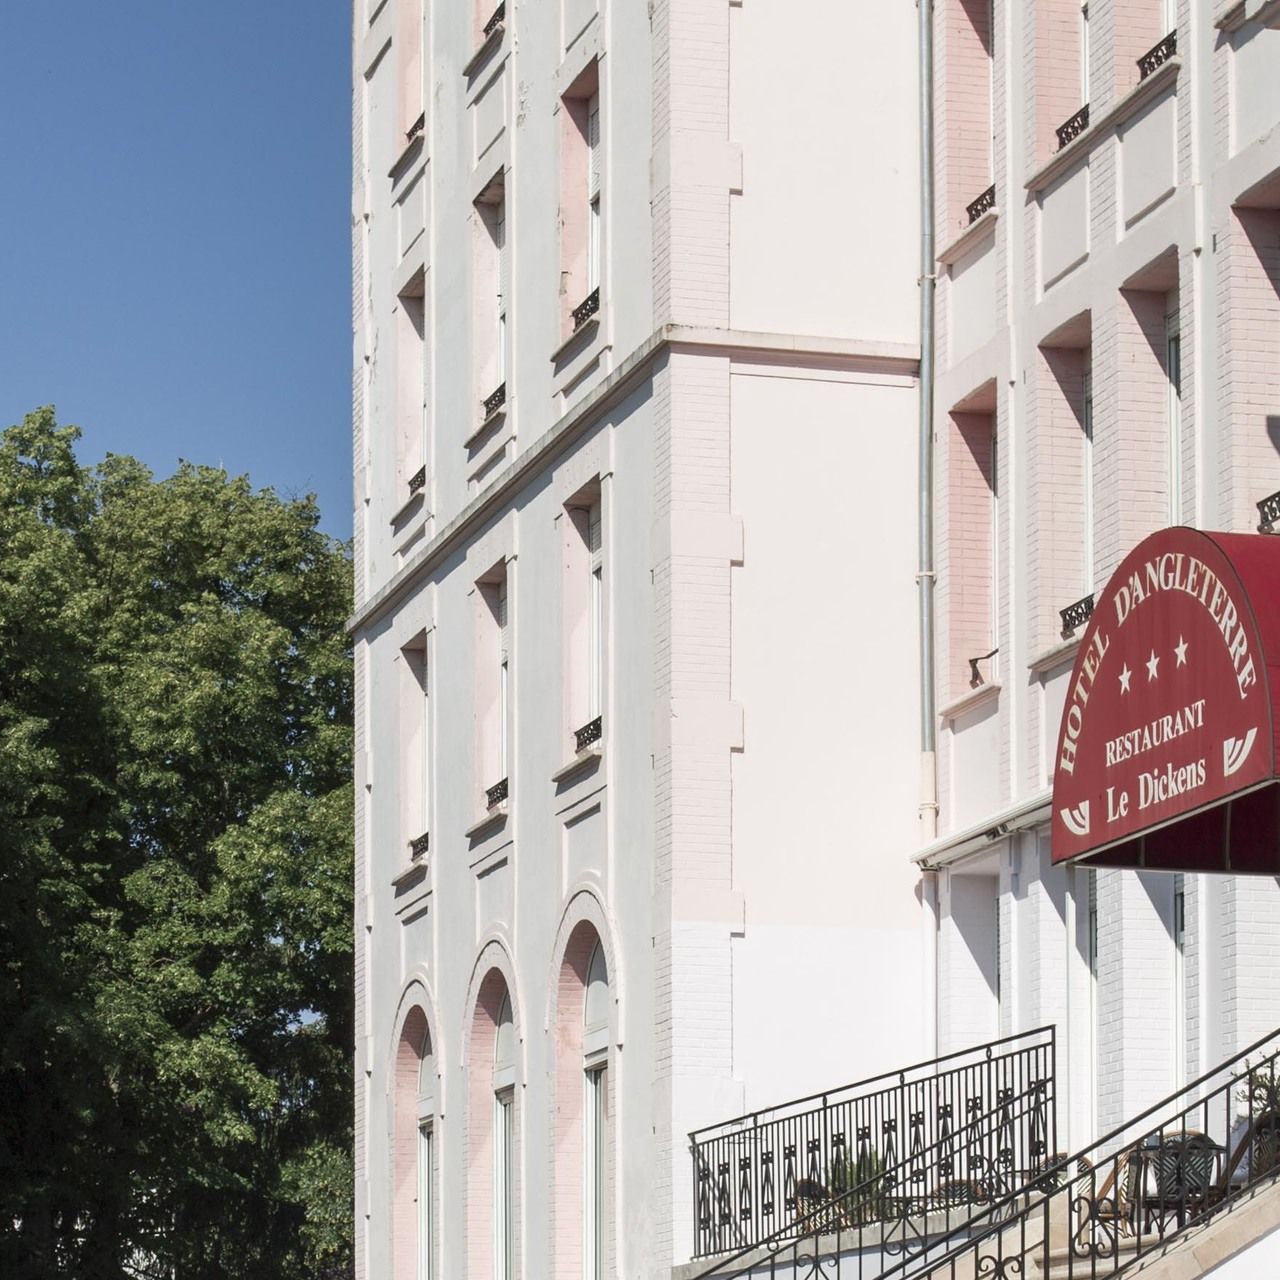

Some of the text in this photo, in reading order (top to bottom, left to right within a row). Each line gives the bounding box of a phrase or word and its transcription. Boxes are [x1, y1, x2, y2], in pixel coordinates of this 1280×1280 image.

[1060, 553, 1257, 776] HOTEL D'ANGLETERRE
[1105, 699, 1205, 767] RESTAURANT
[1106, 758, 1207, 823] Le Dickens
